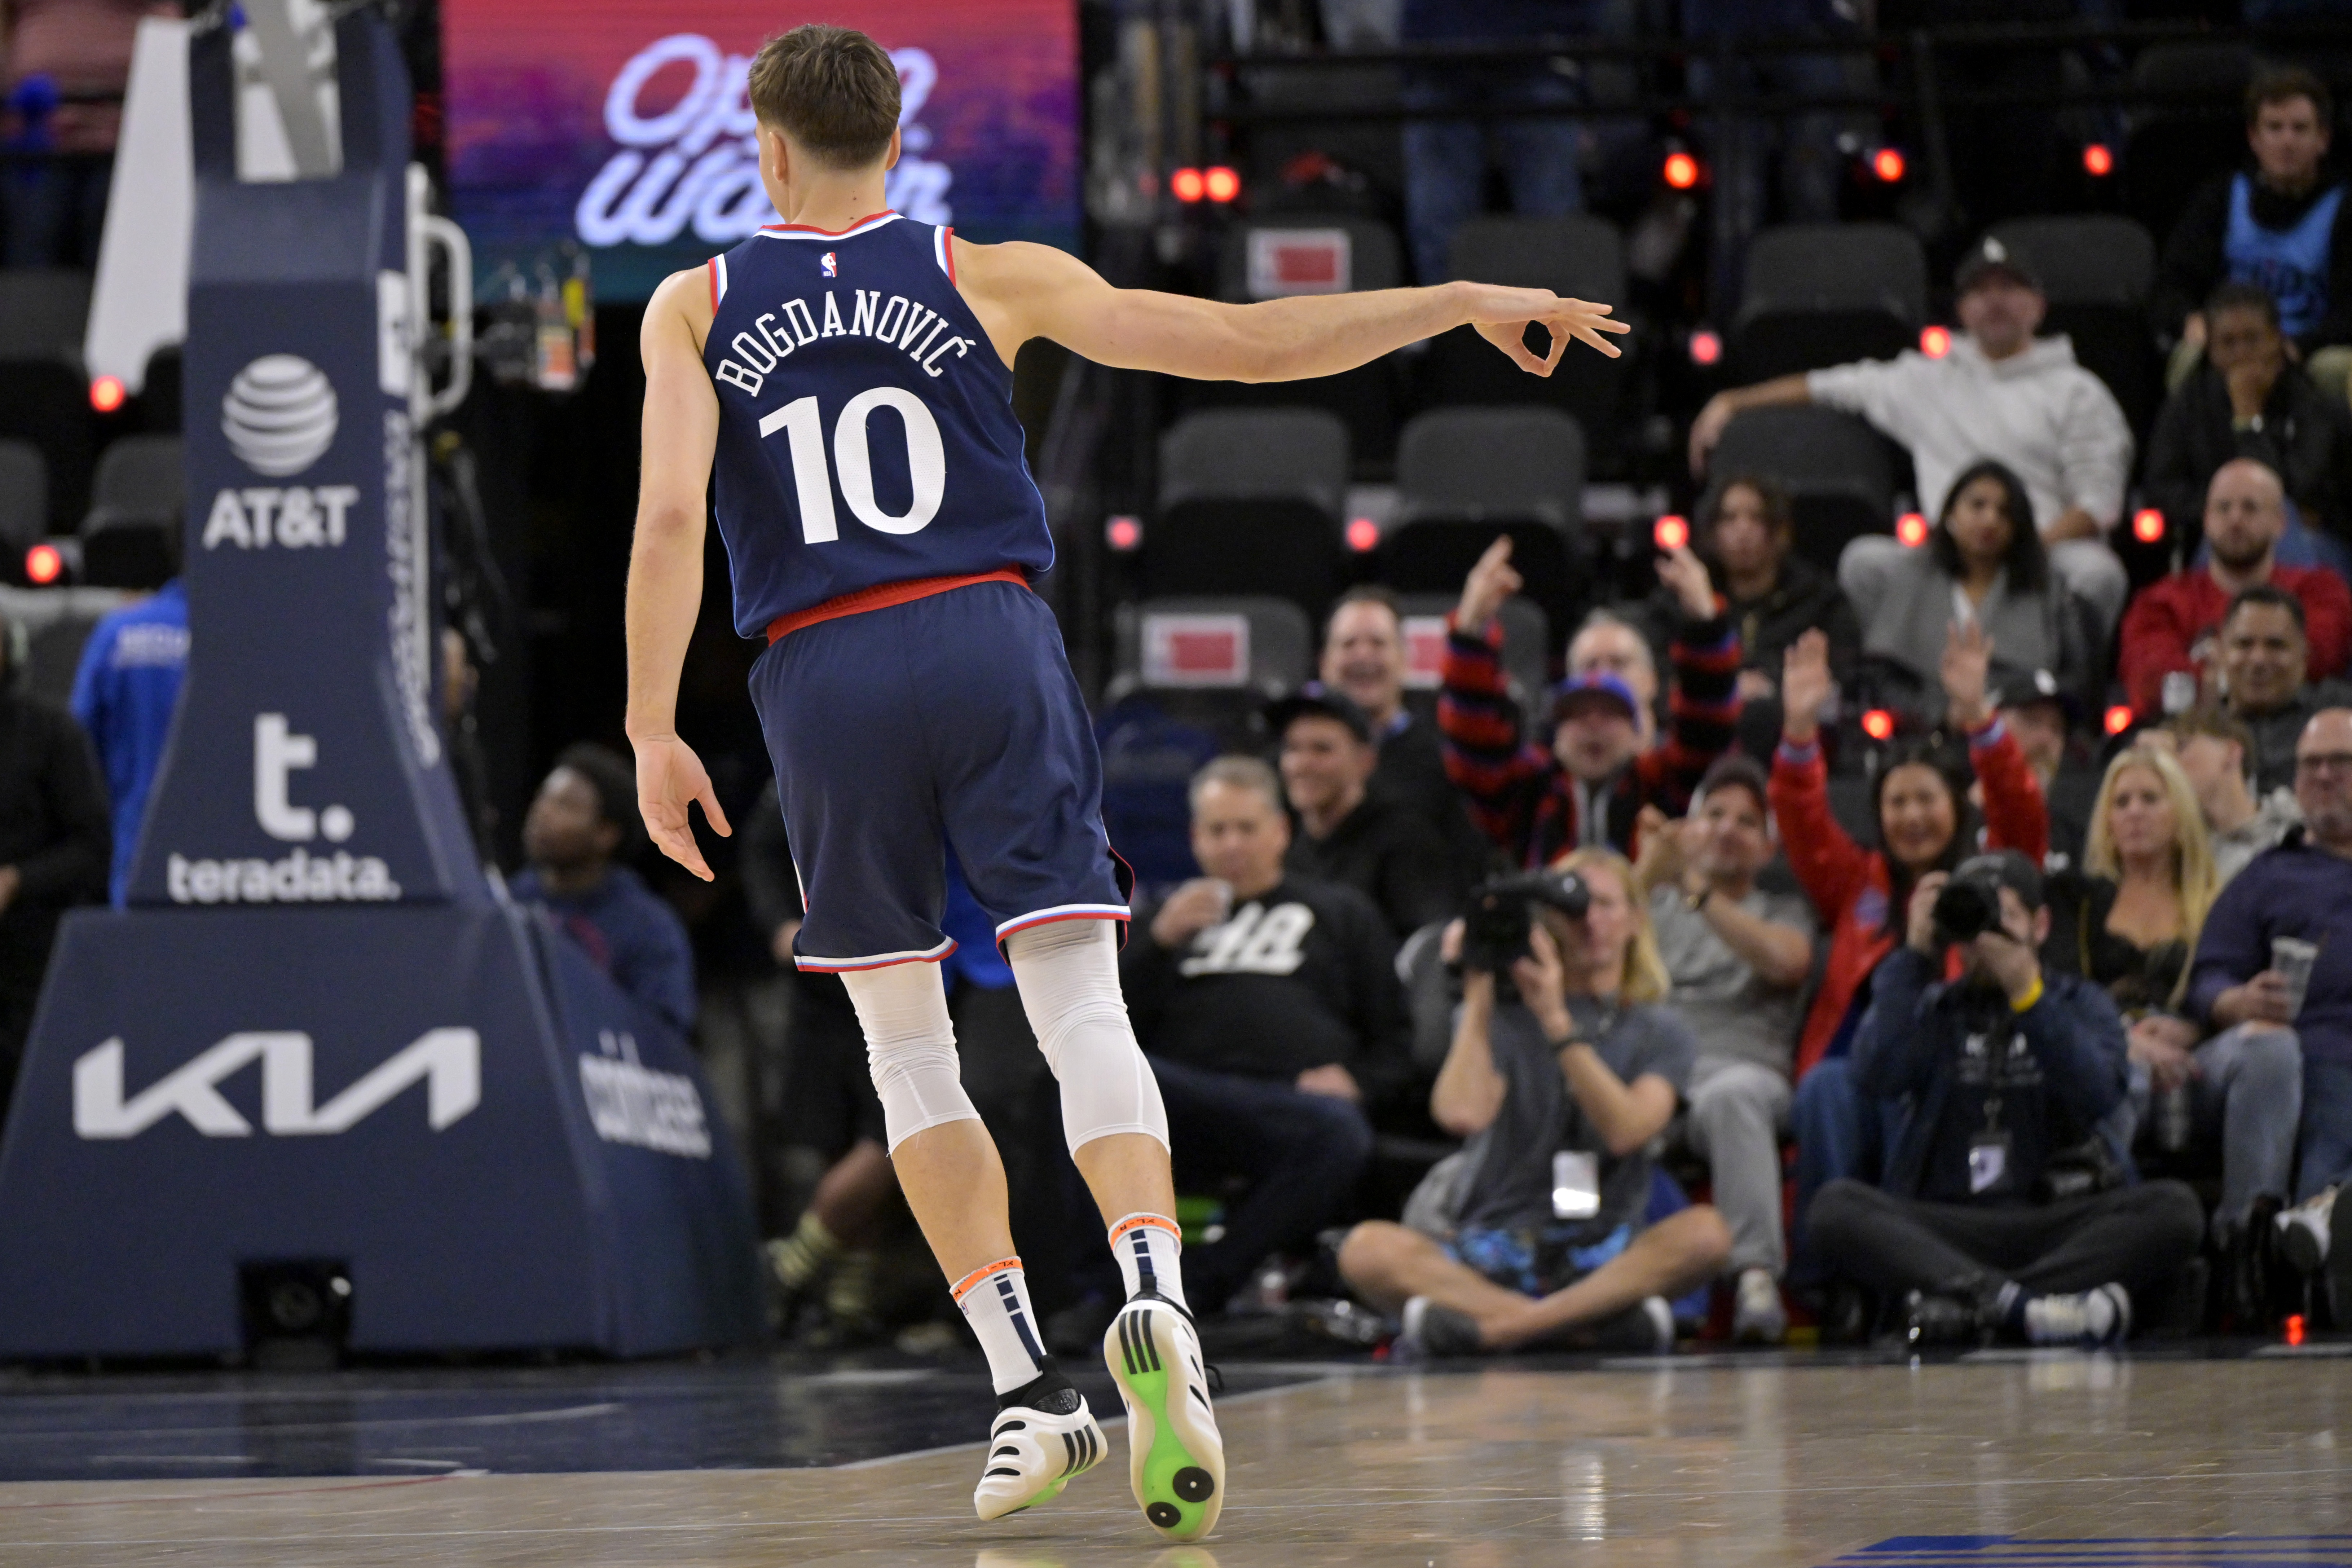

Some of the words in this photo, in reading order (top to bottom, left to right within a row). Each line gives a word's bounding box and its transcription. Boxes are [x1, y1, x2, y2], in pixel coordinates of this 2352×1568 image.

[715, 290, 976, 397] BOGDANOVIĆ
[203, 486, 359, 550] AT&T
[758, 387, 946, 544] 10
[74, 1027, 480, 1138] KIA
